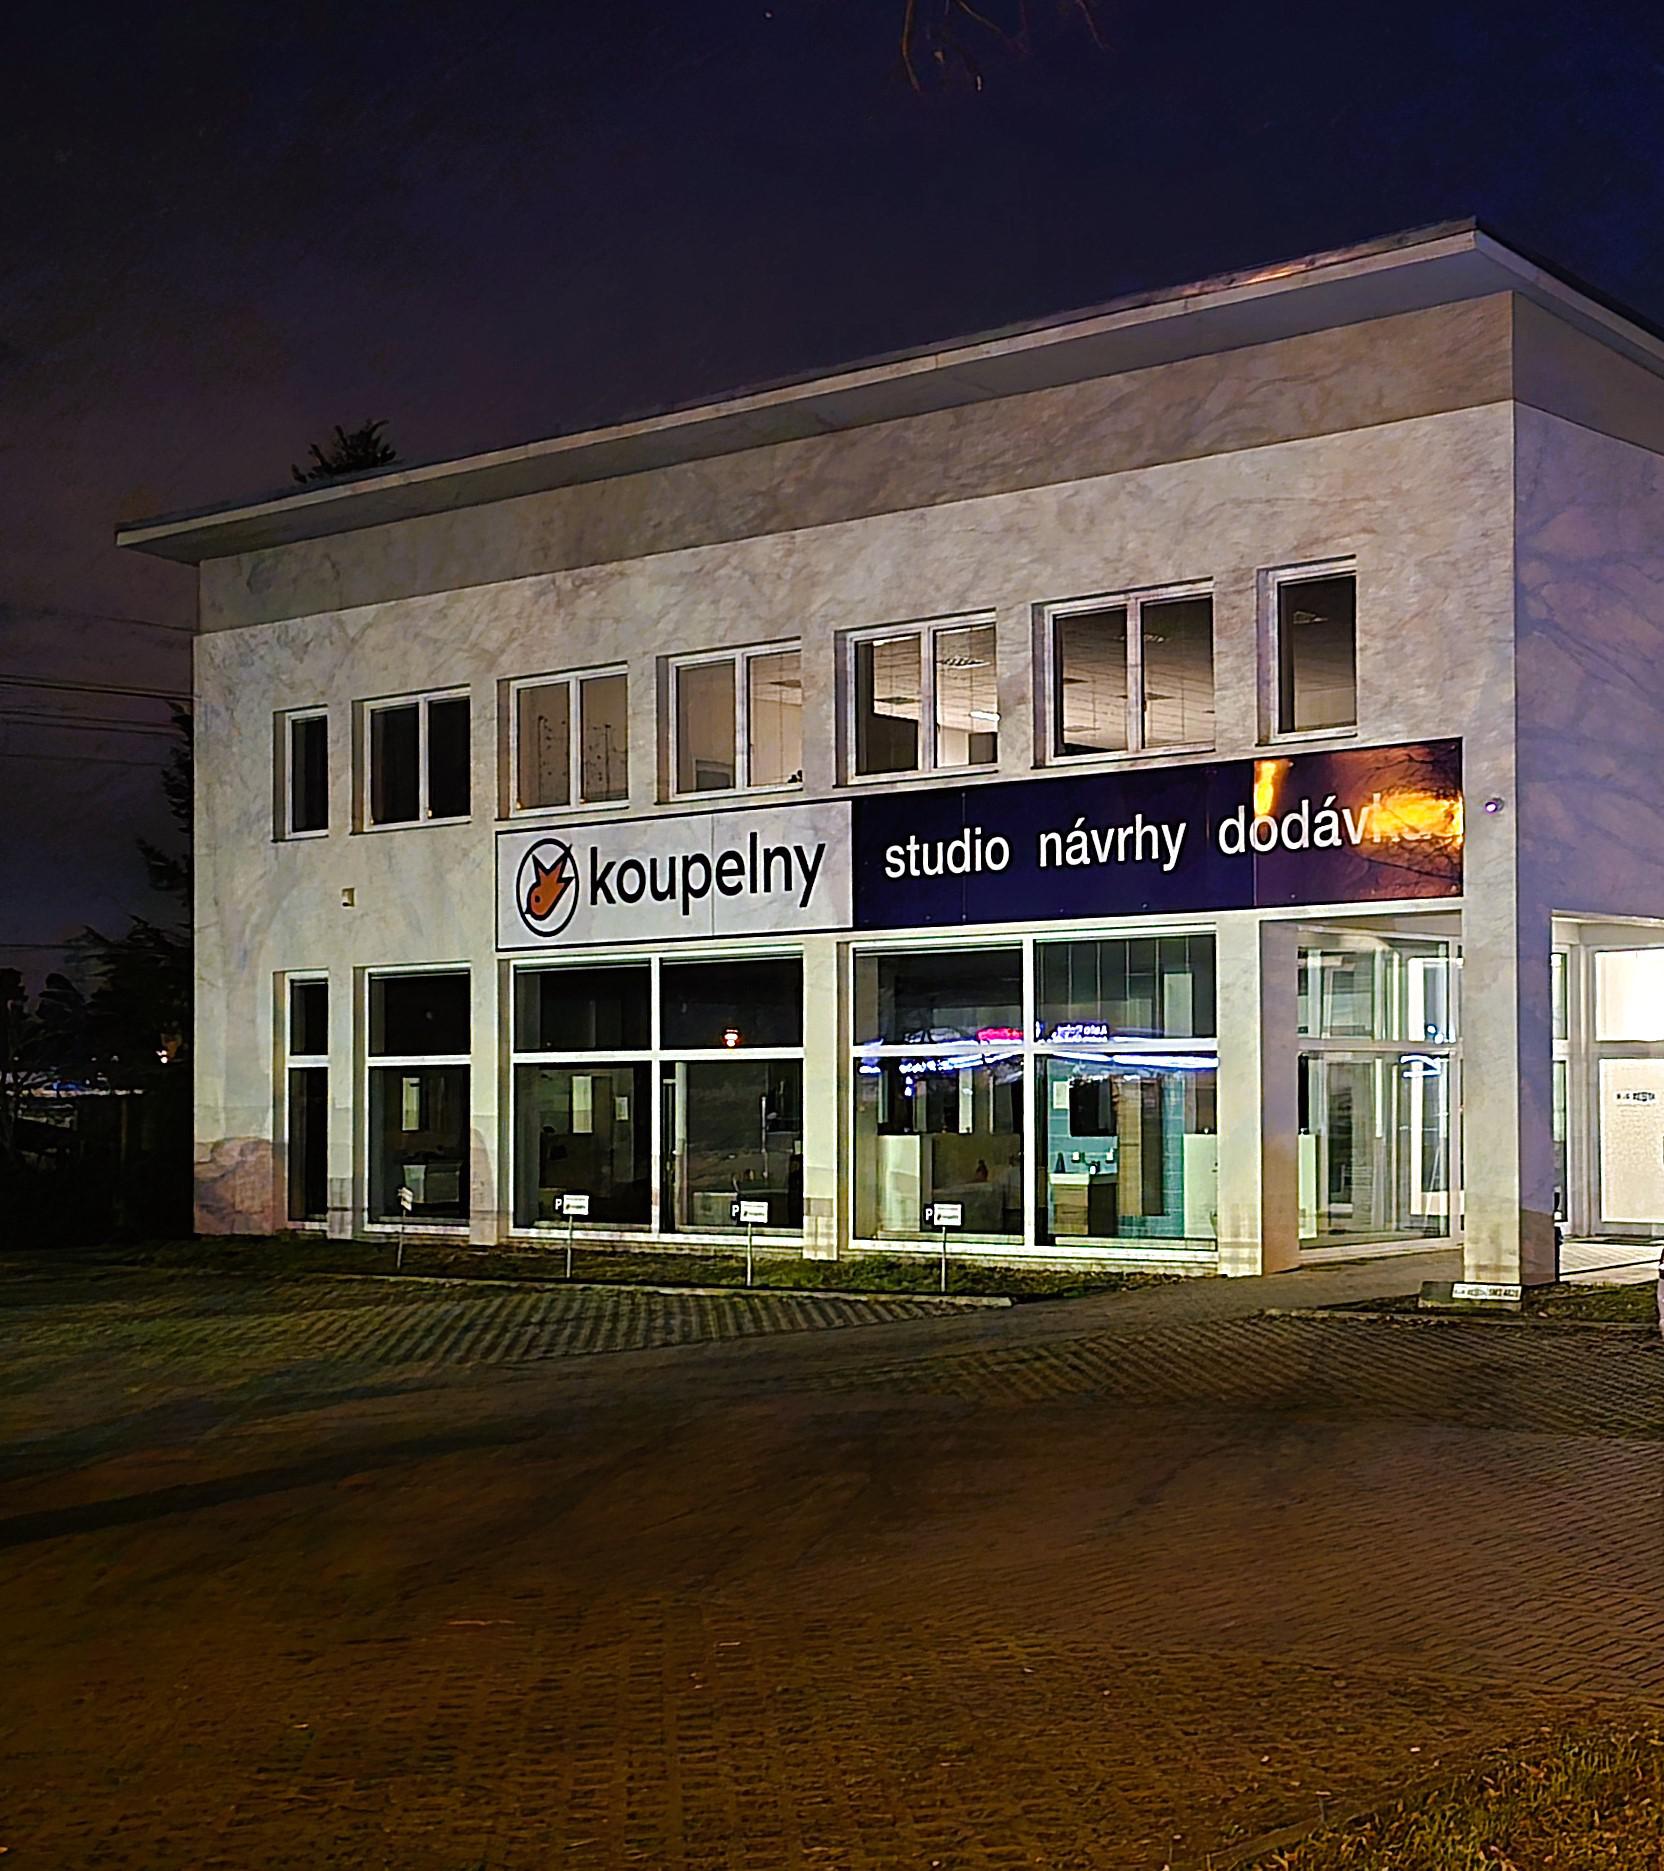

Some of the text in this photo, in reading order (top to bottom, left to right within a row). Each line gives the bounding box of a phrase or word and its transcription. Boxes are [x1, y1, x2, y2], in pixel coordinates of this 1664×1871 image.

[589, 831, 827, 916] koupelny
[884, 826, 1010, 879] studio
[1038, 813, 1187, 872] návrhy
